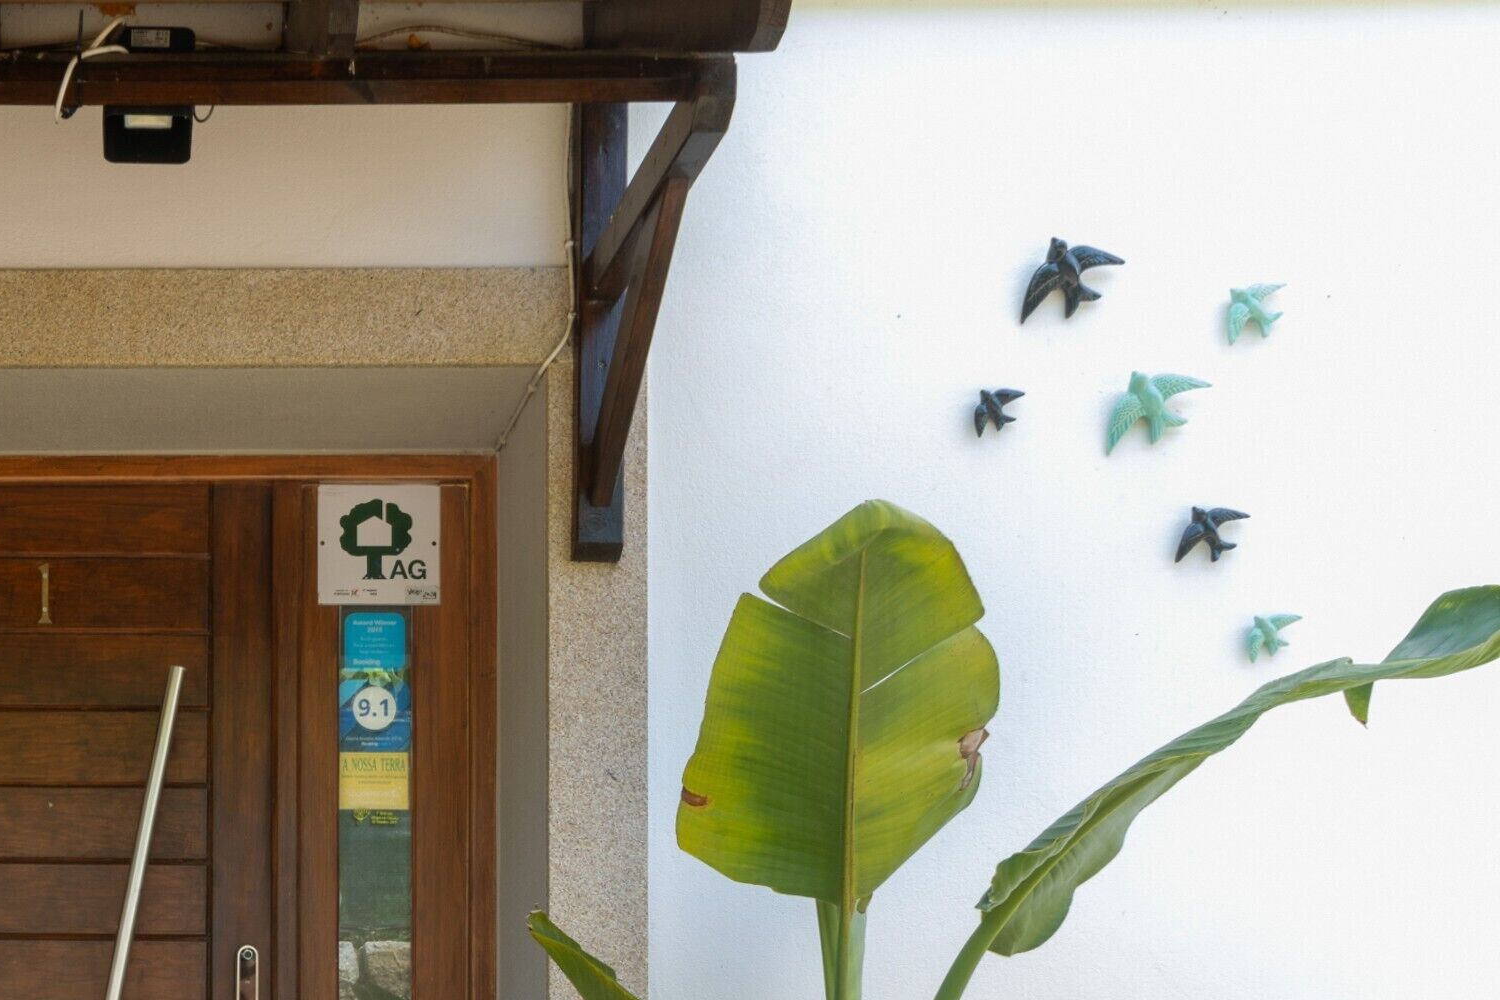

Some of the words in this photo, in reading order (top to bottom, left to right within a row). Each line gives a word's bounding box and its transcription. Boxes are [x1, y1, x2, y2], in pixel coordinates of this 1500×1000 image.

[390, 559, 427, 580] AG
[37, 563, 53, 625] 1
[358, 698, 389, 717] 9.1
